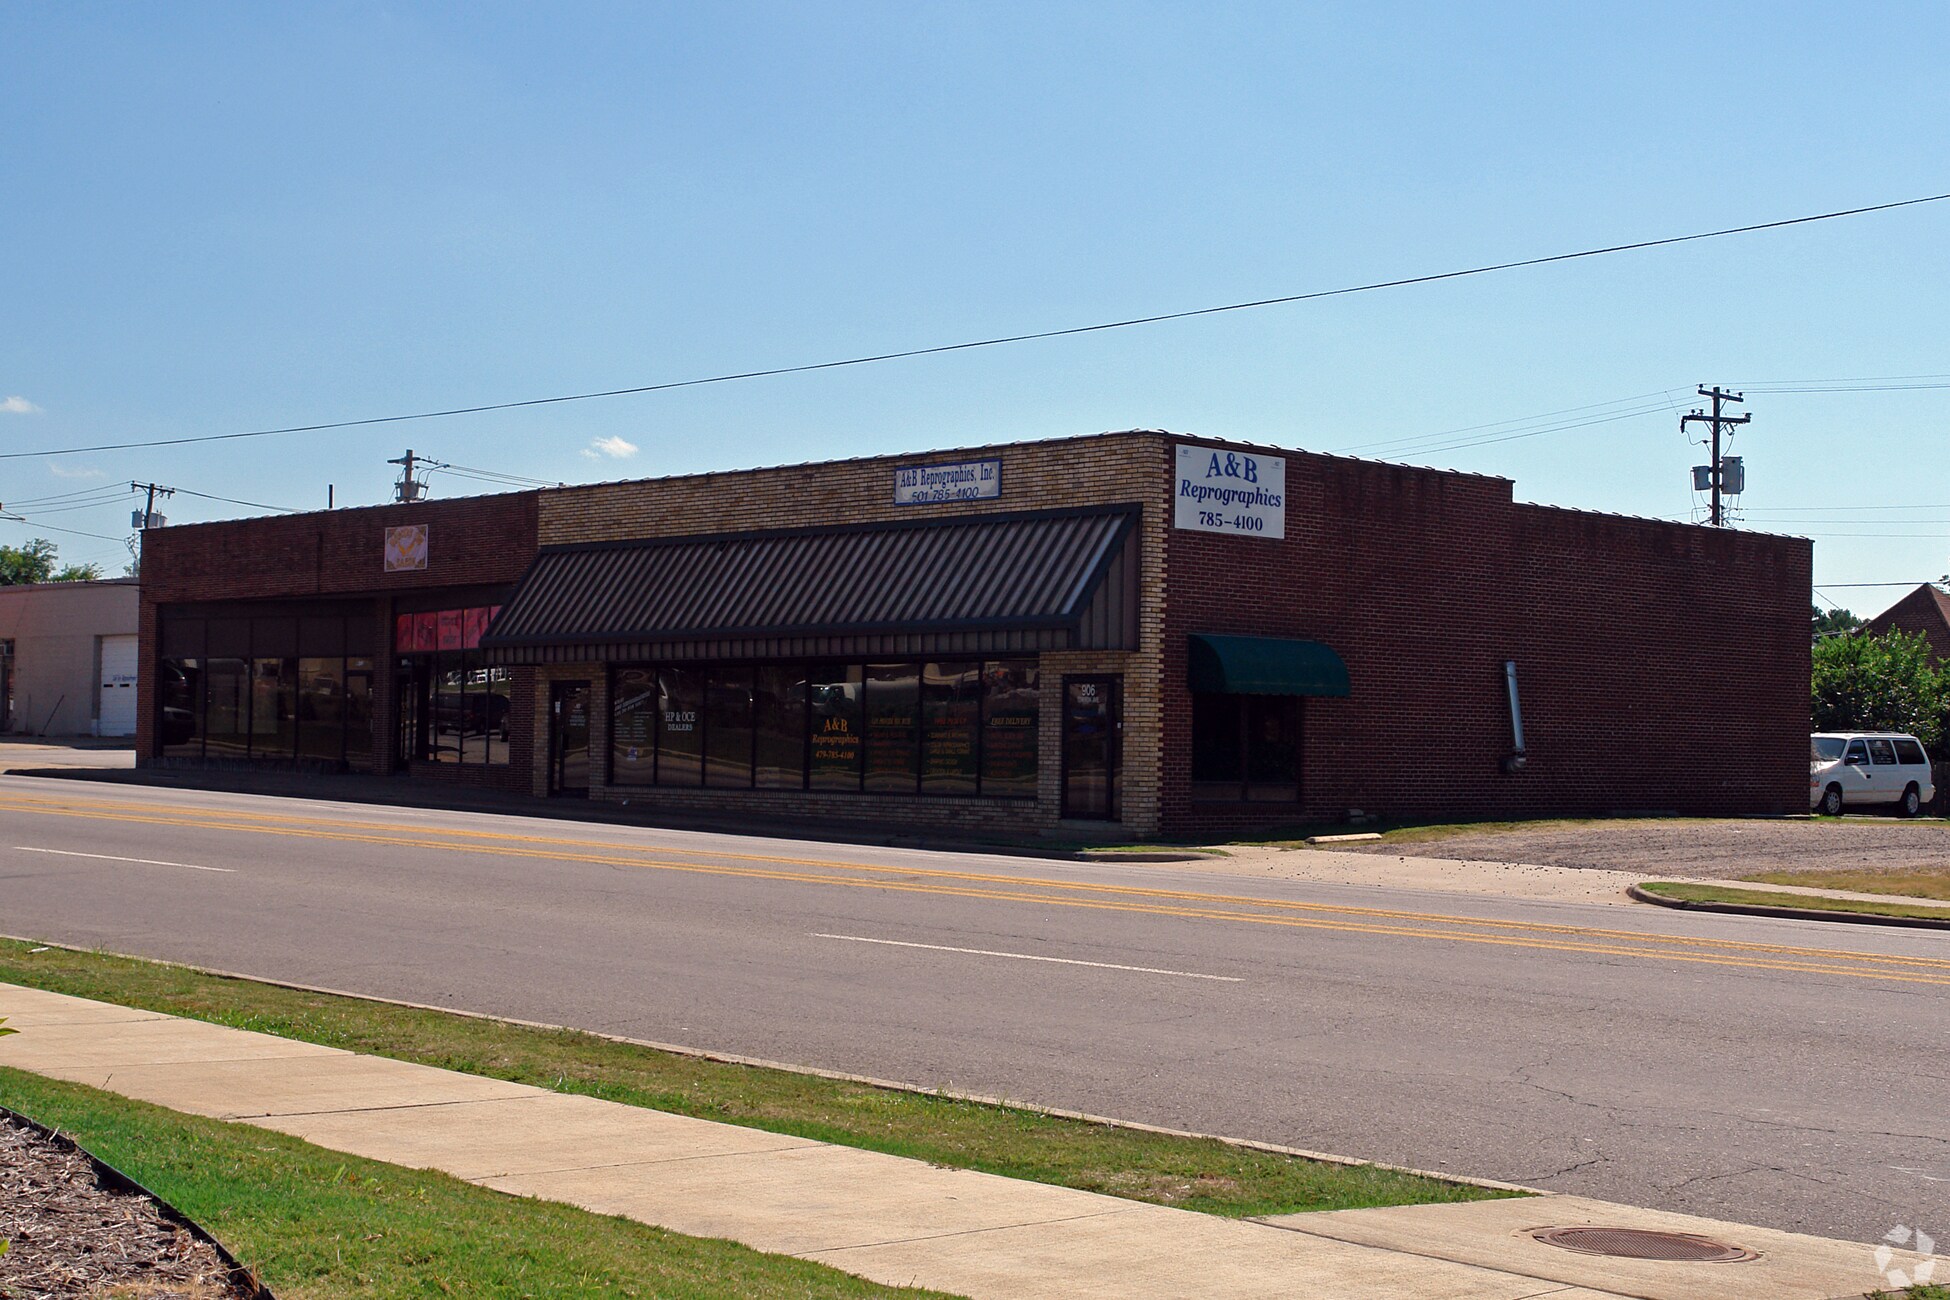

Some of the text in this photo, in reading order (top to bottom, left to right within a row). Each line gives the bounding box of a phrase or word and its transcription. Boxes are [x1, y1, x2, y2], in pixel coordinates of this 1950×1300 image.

[1206, 452, 1258, 483] A&B
[900, 470, 918, 487] A&B
[980, 464, 994, 481] Inc.
[912, 490, 928, 503] 501
[1180, 479, 1282, 508] Reprographics
[1198, 511, 1263, 531] 785-4100
[1081, 684, 1095, 696] 906
[665, 711, 696, 722] HP & OCE
[1005, 717, 1031, 725] DELIVERY
[667, 723, 693, 731] DEALERS
[811, 733, 860, 746] Reprographics
[815, 750, 855, 760] 479-785-4100
